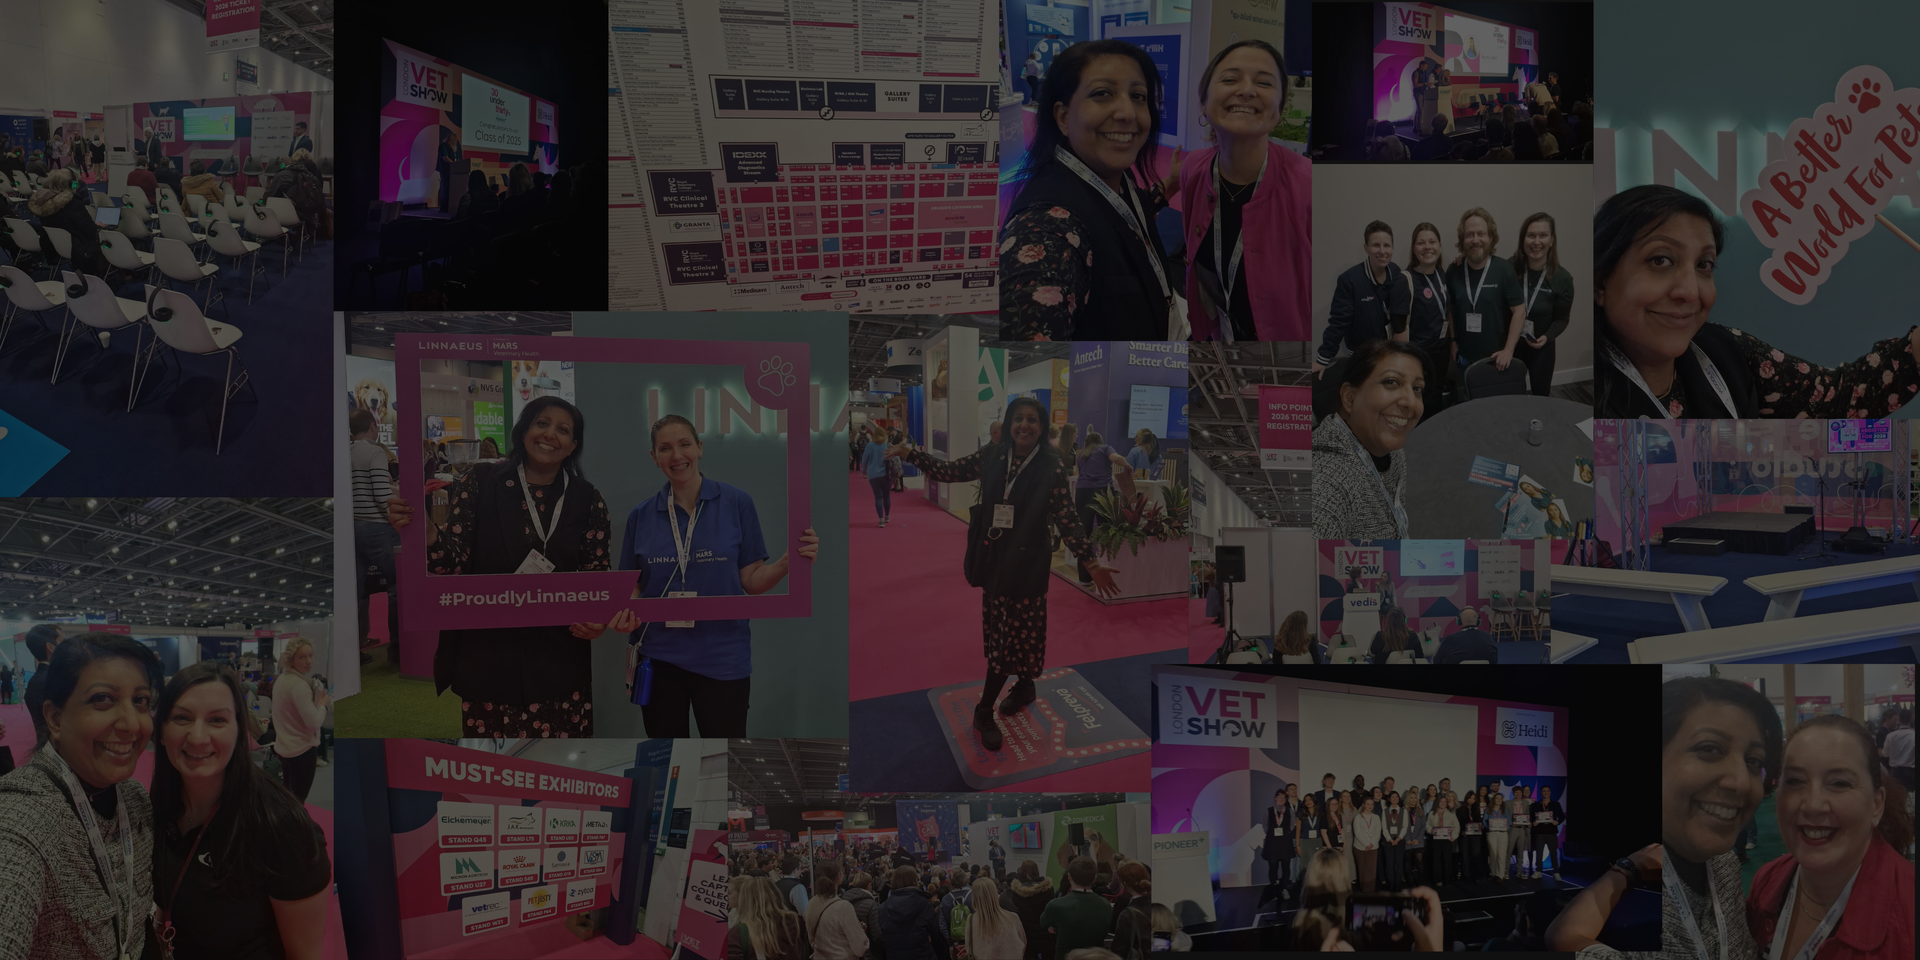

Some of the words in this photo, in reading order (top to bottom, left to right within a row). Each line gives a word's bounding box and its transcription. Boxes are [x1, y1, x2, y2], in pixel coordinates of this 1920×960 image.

[211, 5, 255, 20] REGISTRATION
[215, 2, 229, 11] 2026
[1398, 7, 1432, 29] VET
[1398, 25, 1432, 40] SHOW
[410, 61, 448, 91] VET
[410, 84, 448, 104] SHOW
[491, 87, 499, 97] 30
[489, 96, 506, 106] under
[149, 120, 173, 132] VET
[479, 121, 508, 133] Congratulations
[475, 129, 497, 143] Class
[498, 134, 505, 144] of
[506, 135, 522, 146] 2025
[732, 151, 767, 159] IDEXX
[1769, 114, 1853, 210] Better
[668, 177, 678, 193] RVC
[1751, 199, 1792, 239] A
[1771, 187, 1866, 296] World
[1843, 152, 1893, 206] For
[681, 249, 691, 264] RVC
[418, 341, 483, 351] LINNAEUS
[492, 342, 518, 350] MARS
[1128, 341, 1172, 353] Smarter
[1074, 344, 1103, 366] Antech
[1128, 353, 1162, 366] Better
[1163, 356, 1189, 369] Care.
[561, 361, 574, 370] NEW
[480, 383, 494, 393] NVS
[1268, 403, 1288, 411] INFO
[442, 430, 462, 438] experts
[695, 550, 713, 559] MARS
[1344, 550, 1380, 565] VET
[439, 588, 611, 608] #ProudlyLinnaeus
[1350, 597, 1378, 607] vedis
[950, 701, 960, 713] the
[1056, 687, 1102, 730] Felpreva
[1184, 685, 1266, 720] VET
[1171, 684, 1183, 735] LONDON
[1013, 726, 1025, 739] ears
[1187, 717, 1266, 738] SHOW
[1518, 724, 1548, 738] Heidi
[963, 727, 989, 764] Looking
[1022, 740, 1038, 754] your
[1010, 745, 1026, 762] Head
[425, 756, 536, 789] MUST-SEE
[538, 775, 620, 799] EXHIBITORS
[559, 820, 577, 828] KRKA
[1071, 815, 1105, 823] ZOMEDICA
[921, 825, 935, 834] CAT
[987, 826, 1000, 835] VET
[502, 863, 519, 871] ROYAL
[518, 862, 536, 870] CANIN
[450, 883, 474, 892] STAND
[471, 902, 500, 913] vetrec
[470, 922, 492, 931] STAND
[492, 919, 504, 927] W21
[683, 933, 701, 945] VET
